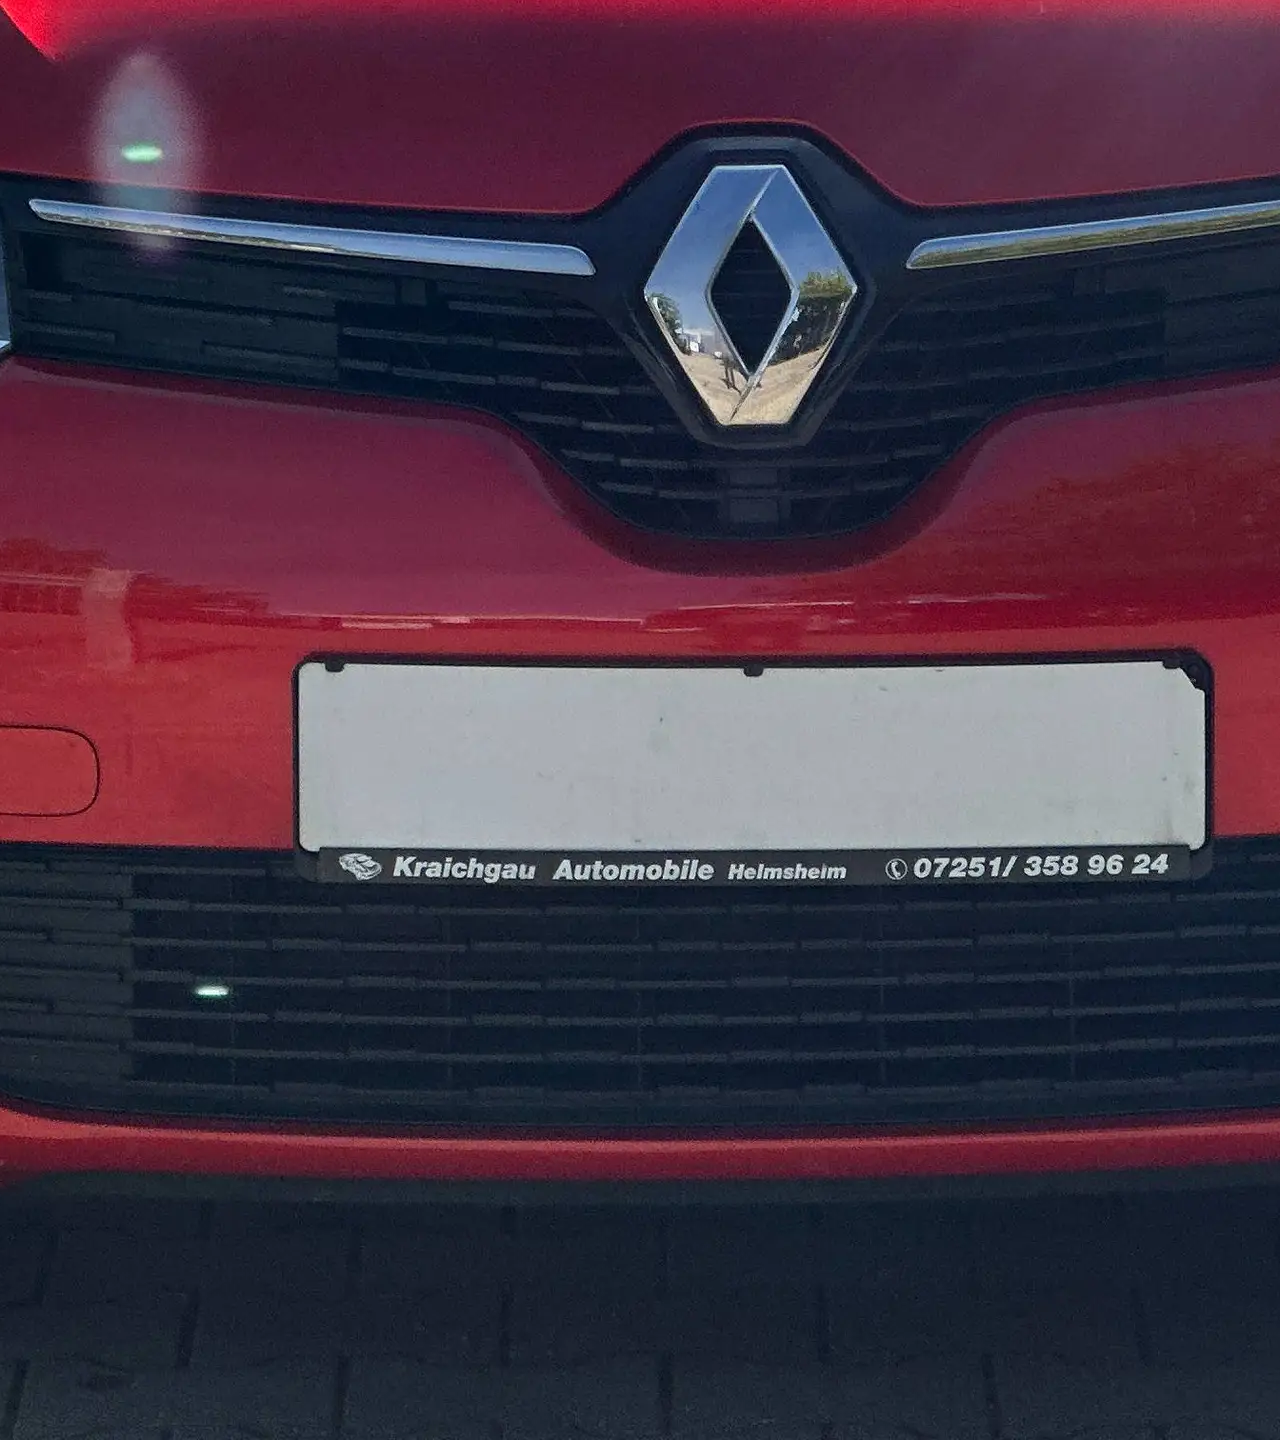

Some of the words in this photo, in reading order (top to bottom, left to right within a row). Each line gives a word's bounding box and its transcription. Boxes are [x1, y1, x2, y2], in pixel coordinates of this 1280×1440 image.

[392, 855, 537, 884] Kraichgau
[553, 858, 715, 881] Automobile
[728, 863, 848, 881] Helmsheim
[913, 855, 1019, 878] 07251/
[1023, 854, 1079, 877] 358
[1087, 854, 1125, 876] 96
[1131, 853, 1169, 875] 24
